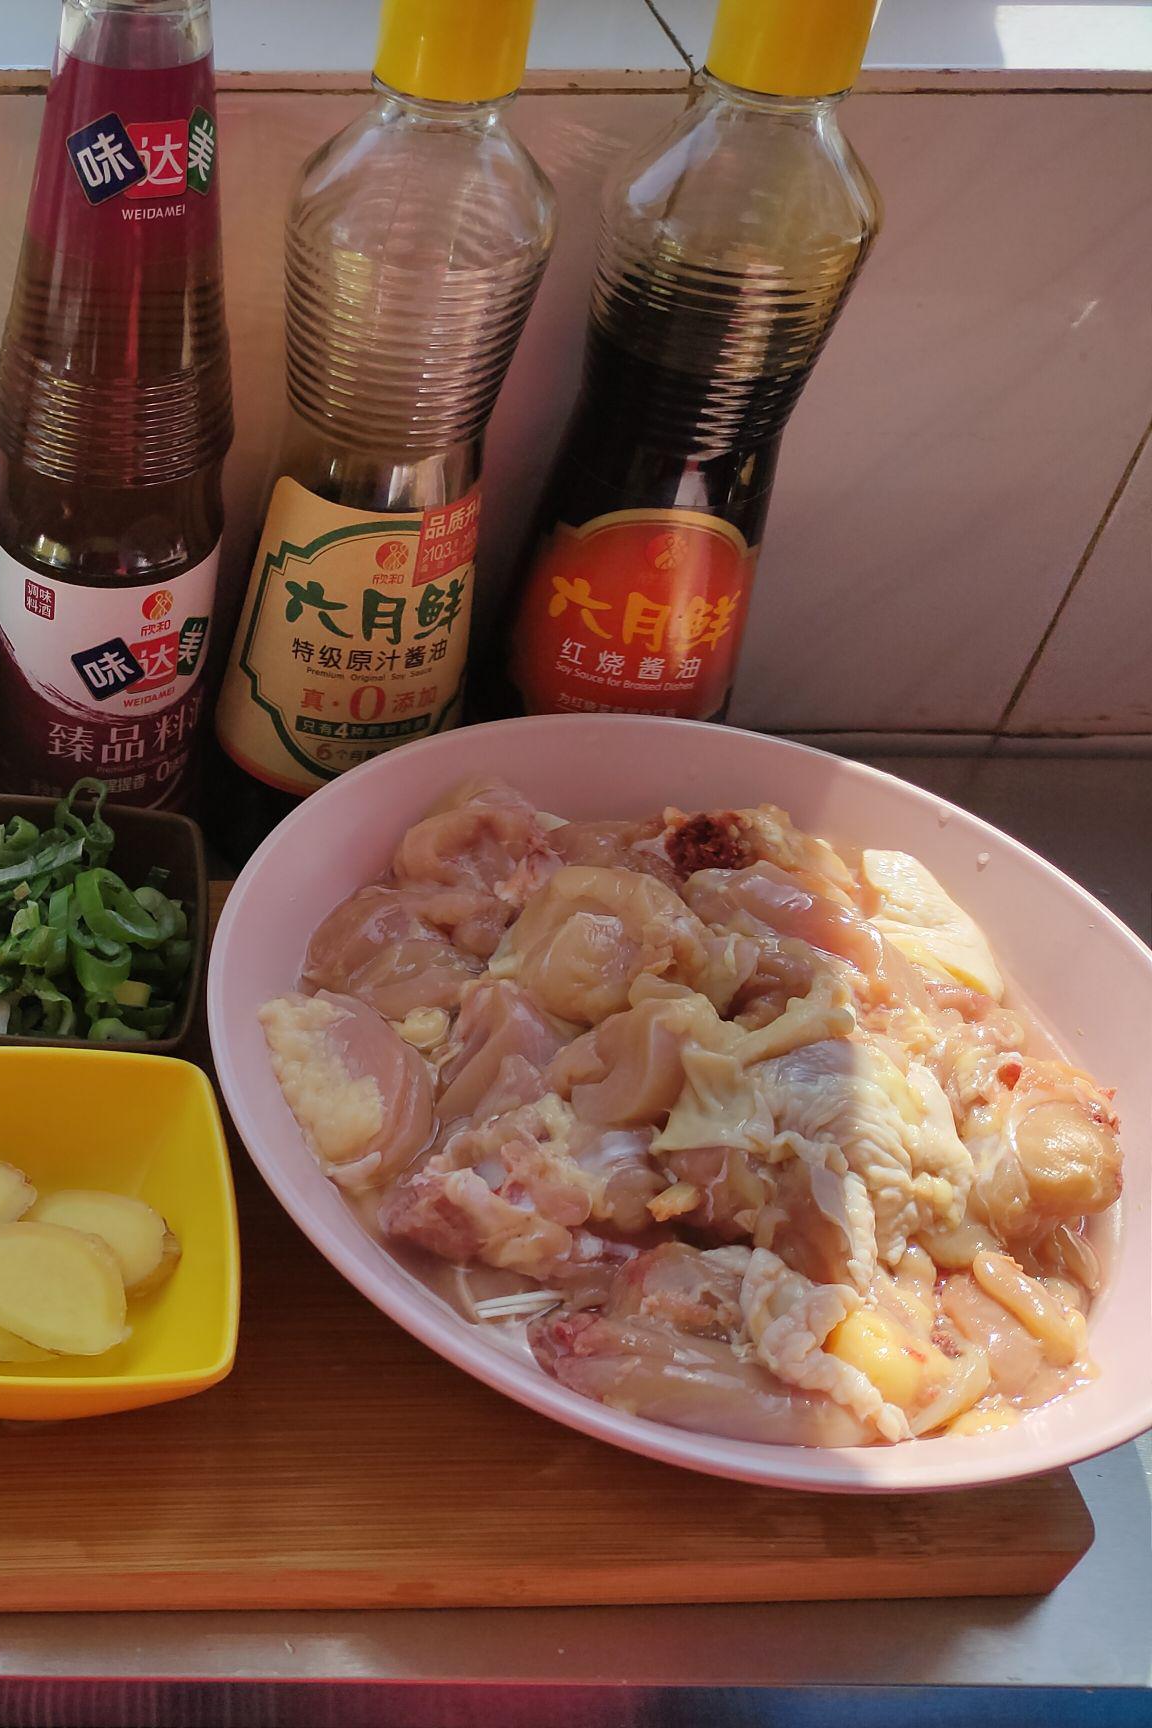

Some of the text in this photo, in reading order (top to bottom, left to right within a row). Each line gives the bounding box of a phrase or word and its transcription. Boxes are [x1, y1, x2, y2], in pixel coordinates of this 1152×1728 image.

[77, 119, 215, 187] 味达美
[121, 204, 186, 220] WEIDAMEI
[425, 497, 480, 541] 品质升
[284, 570, 469, 645] 六月鲜
[549, 576, 741, 652] 六月鲜
[82, 622, 205, 688] 味达美
[291, 638, 448, 672] 特级原汁酱油
[306, 666, 345, 680] Premium
[350, 673, 386, 683] Original
[555, 660, 572, 673] Soy
[574, 668, 605, 685] Sauce
[607, 676, 622, 688] for
[623, 680, 662, 691] Braised
[559, 637, 702, 680] 红烧酱油
[123, 686, 176, 708] WEIDAMEI
